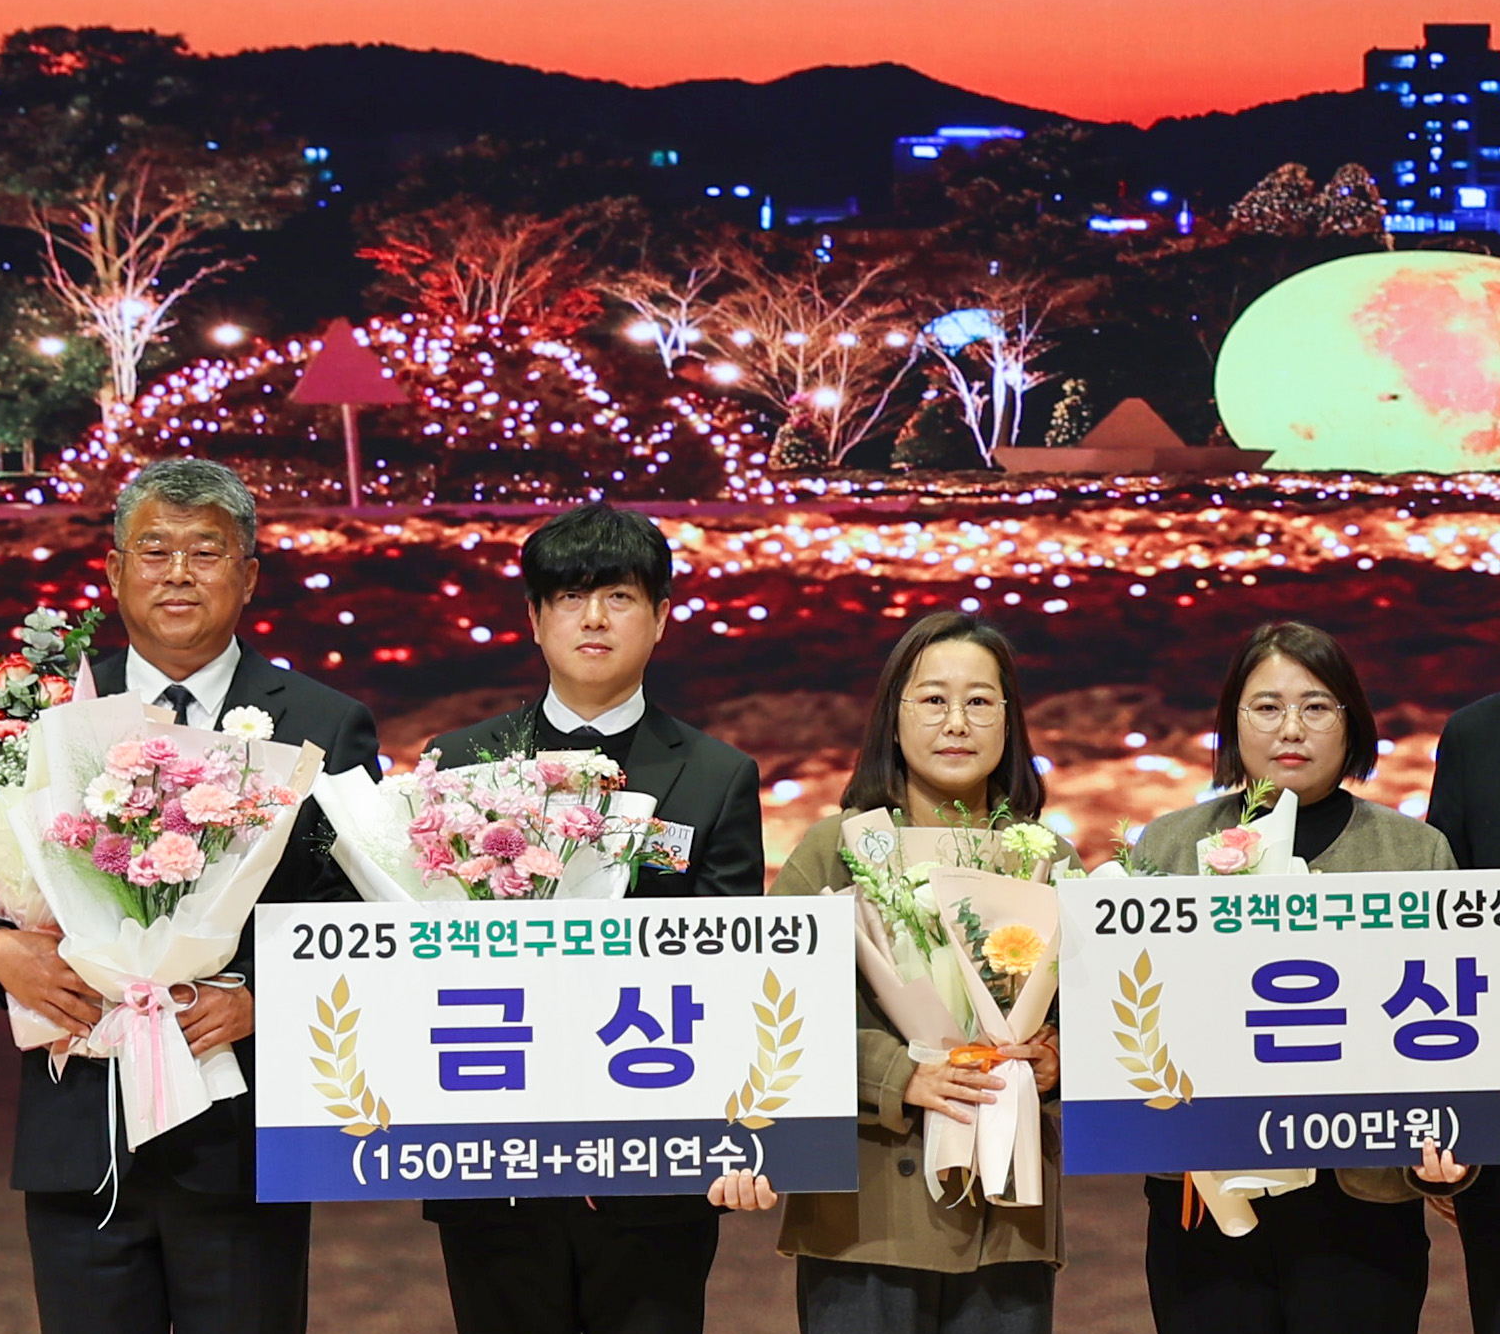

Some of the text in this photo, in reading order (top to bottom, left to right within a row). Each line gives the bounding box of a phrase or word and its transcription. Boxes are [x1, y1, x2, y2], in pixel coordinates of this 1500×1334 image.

[1095, 897, 1198, 935] 2025
[292, 922, 398, 960] 2025
[1257, 1105, 1461, 1155] (100만원)
[351, 1133, 767, 1185] (150만원+해외연수)
